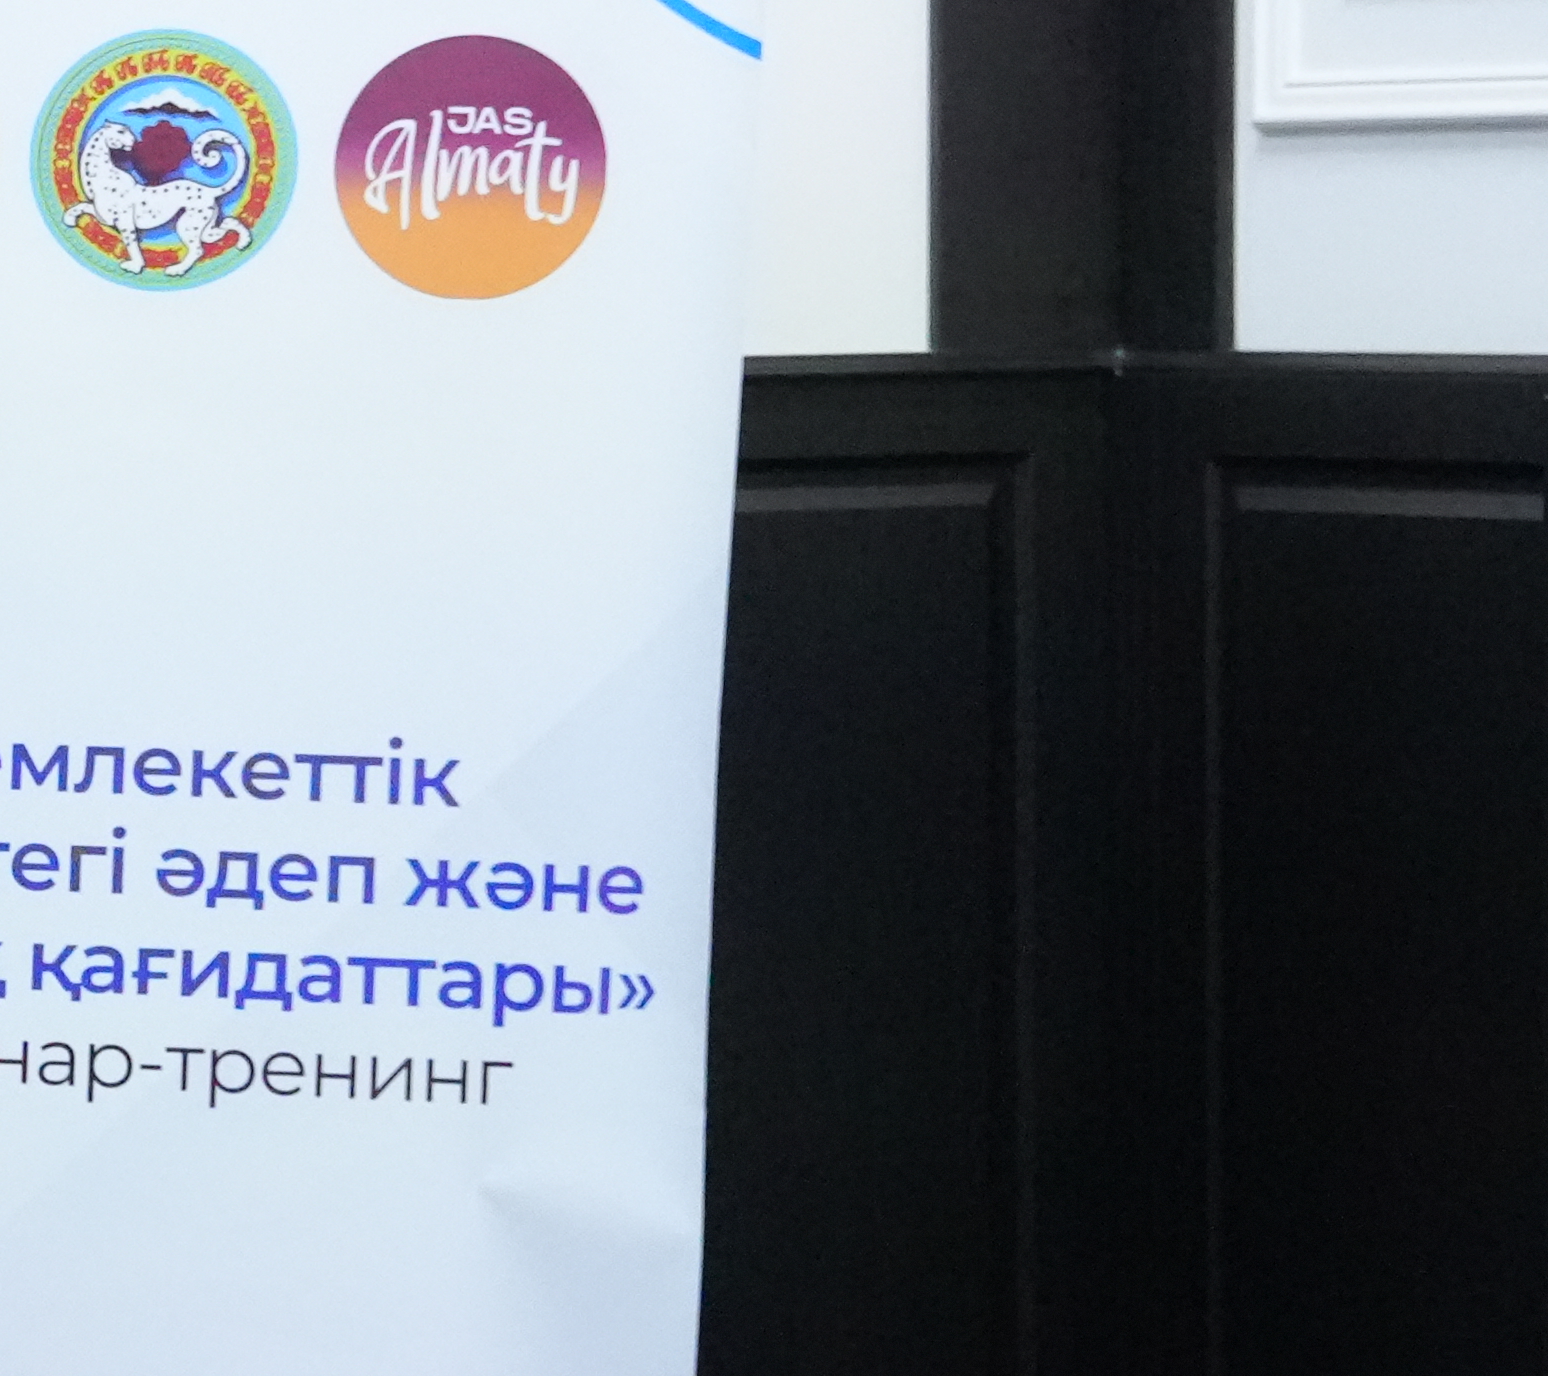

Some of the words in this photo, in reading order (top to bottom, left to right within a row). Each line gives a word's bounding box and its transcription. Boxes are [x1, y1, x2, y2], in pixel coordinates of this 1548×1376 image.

[446, 105, 534, 136] JAS
[363, 109, 581, 231] Almaty
[155, 848, 376, 911] әдеп
[403, 858, 645, 915] және
[31, 942, 656, 1028] қағидаттары»
